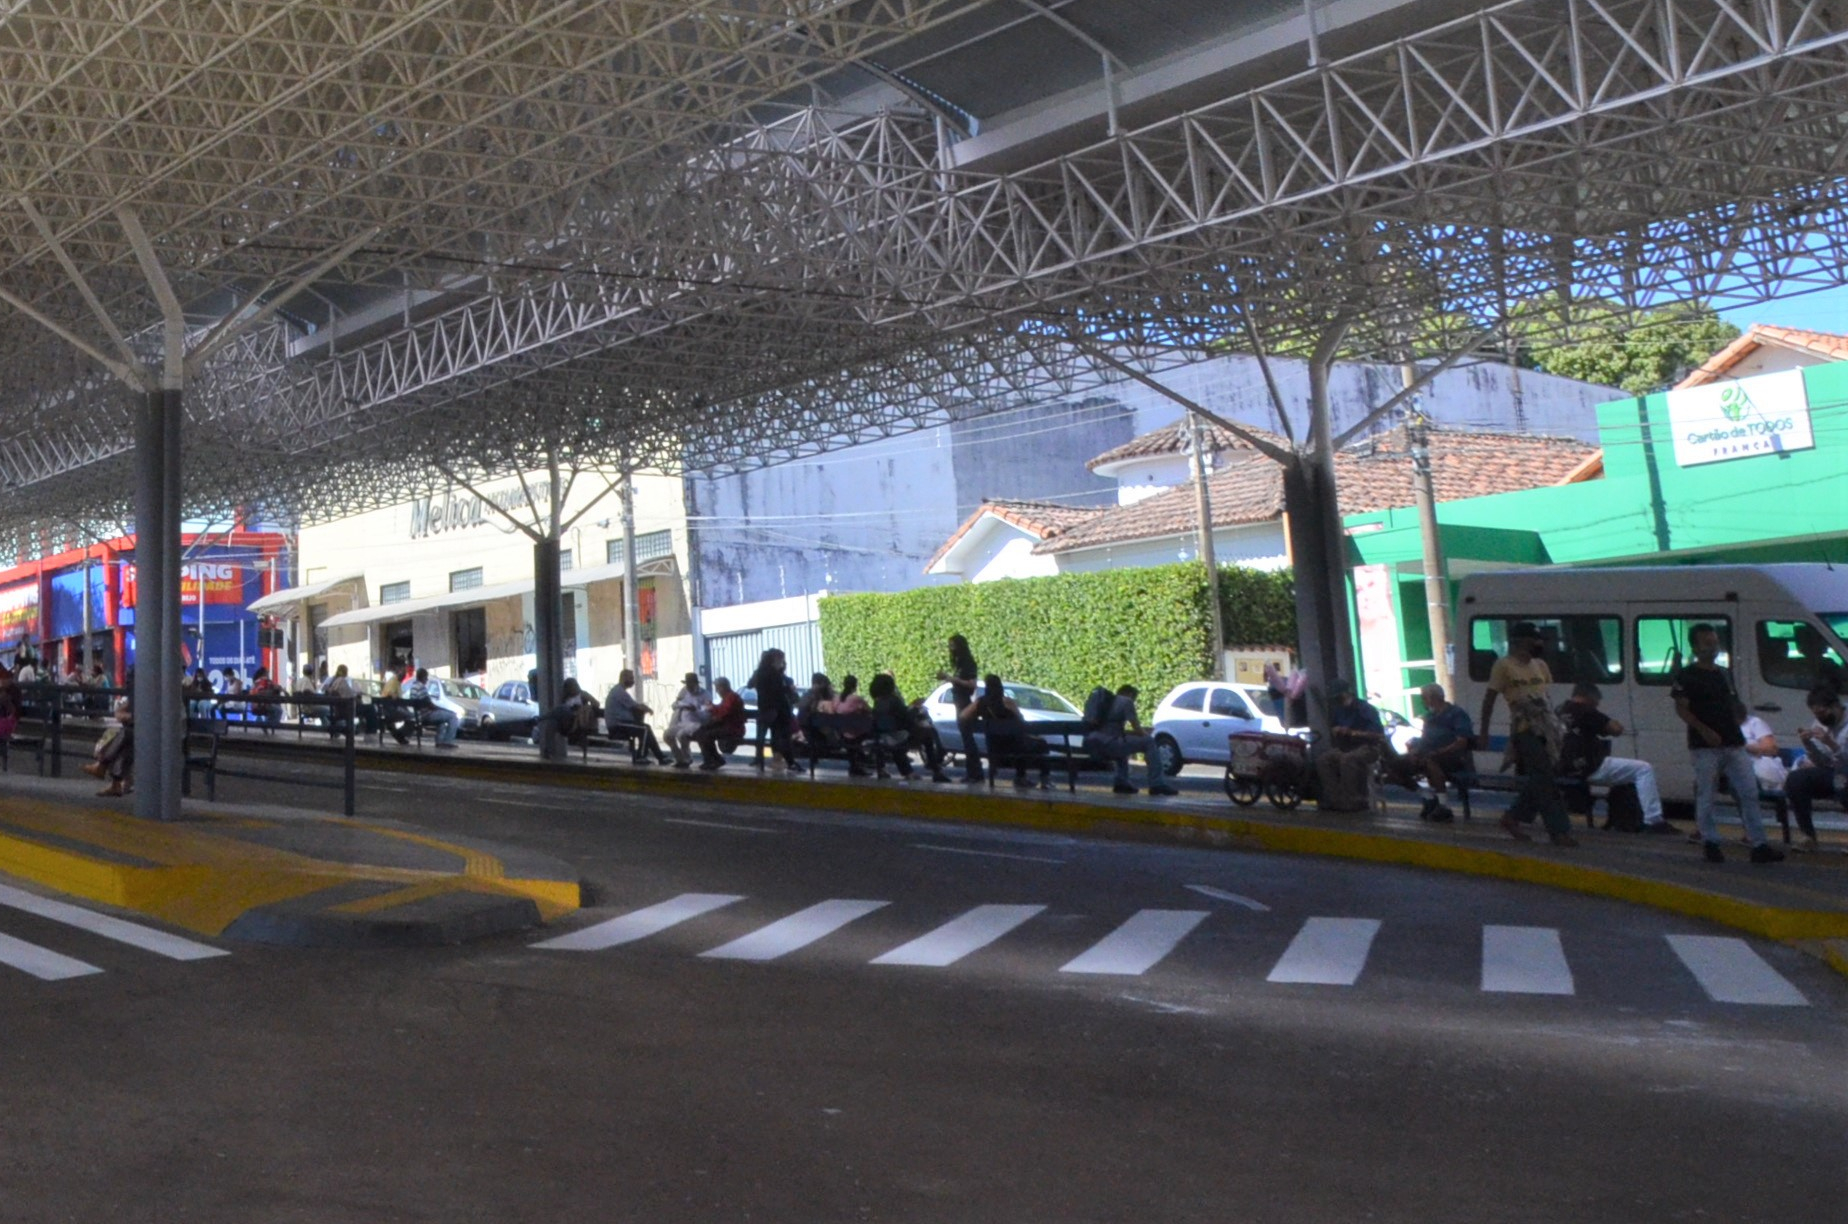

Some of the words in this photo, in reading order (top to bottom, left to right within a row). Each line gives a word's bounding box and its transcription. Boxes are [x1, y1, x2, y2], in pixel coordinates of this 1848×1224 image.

[1687, 428, 1729, 445] Cartão
[1730, 425, 1746, 438] de
[1747, 417, 1794, 436] TODOS
